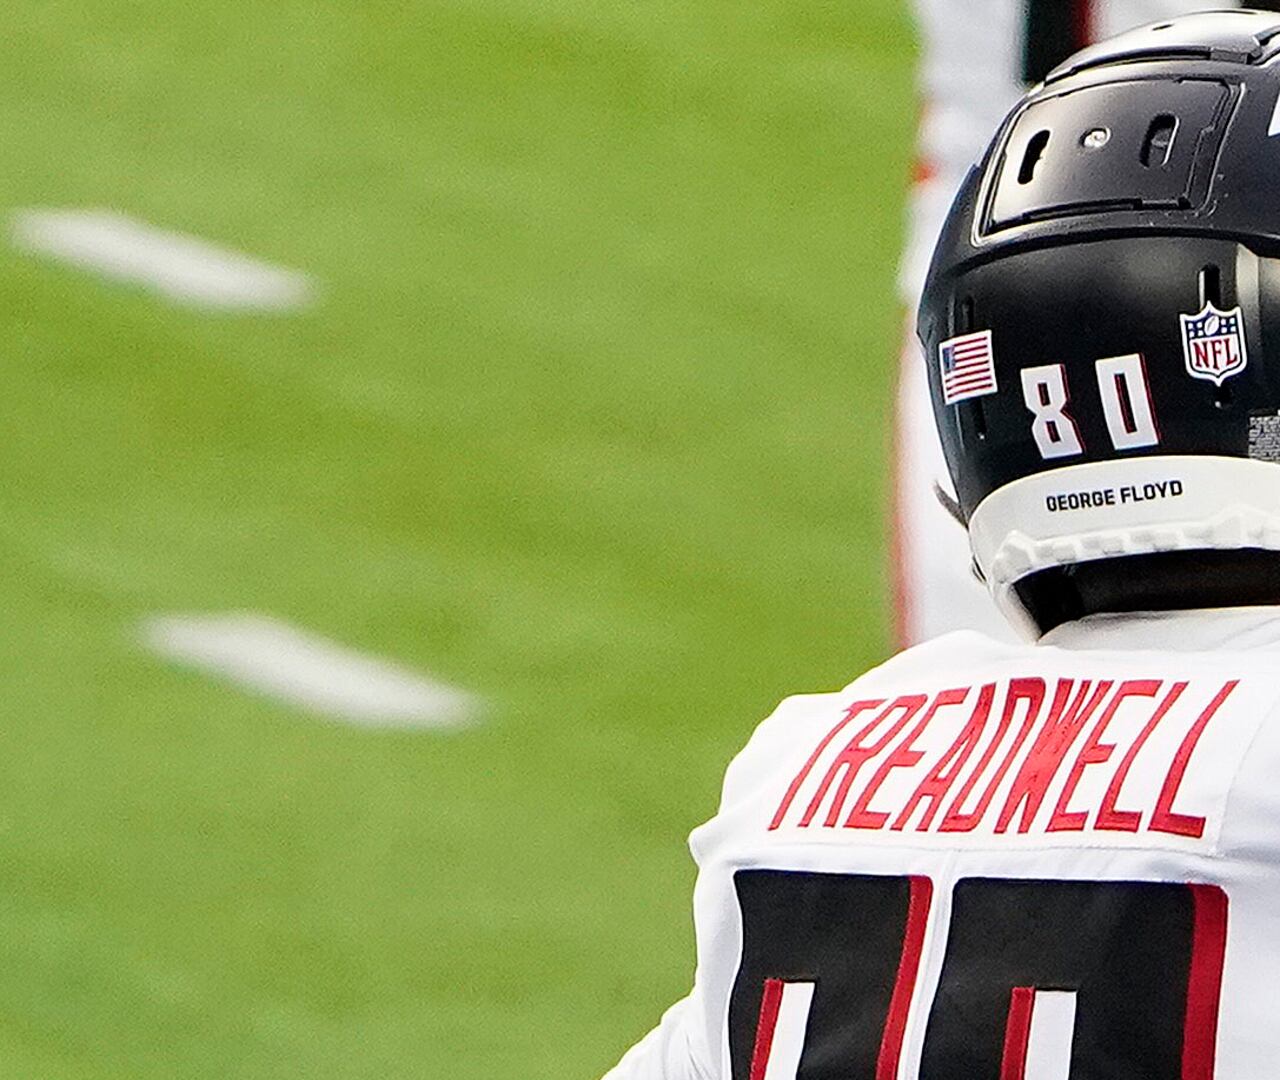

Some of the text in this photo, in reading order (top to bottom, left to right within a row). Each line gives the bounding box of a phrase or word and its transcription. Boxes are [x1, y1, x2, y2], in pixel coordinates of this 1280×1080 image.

[1193, 338, 1238, 371] NFL
[1020, 352, 1164, 460] 80
[1046, 479, 1184, 512] GEORGE FLOYD
[767, 677, 1240, 839] TREADWELL
